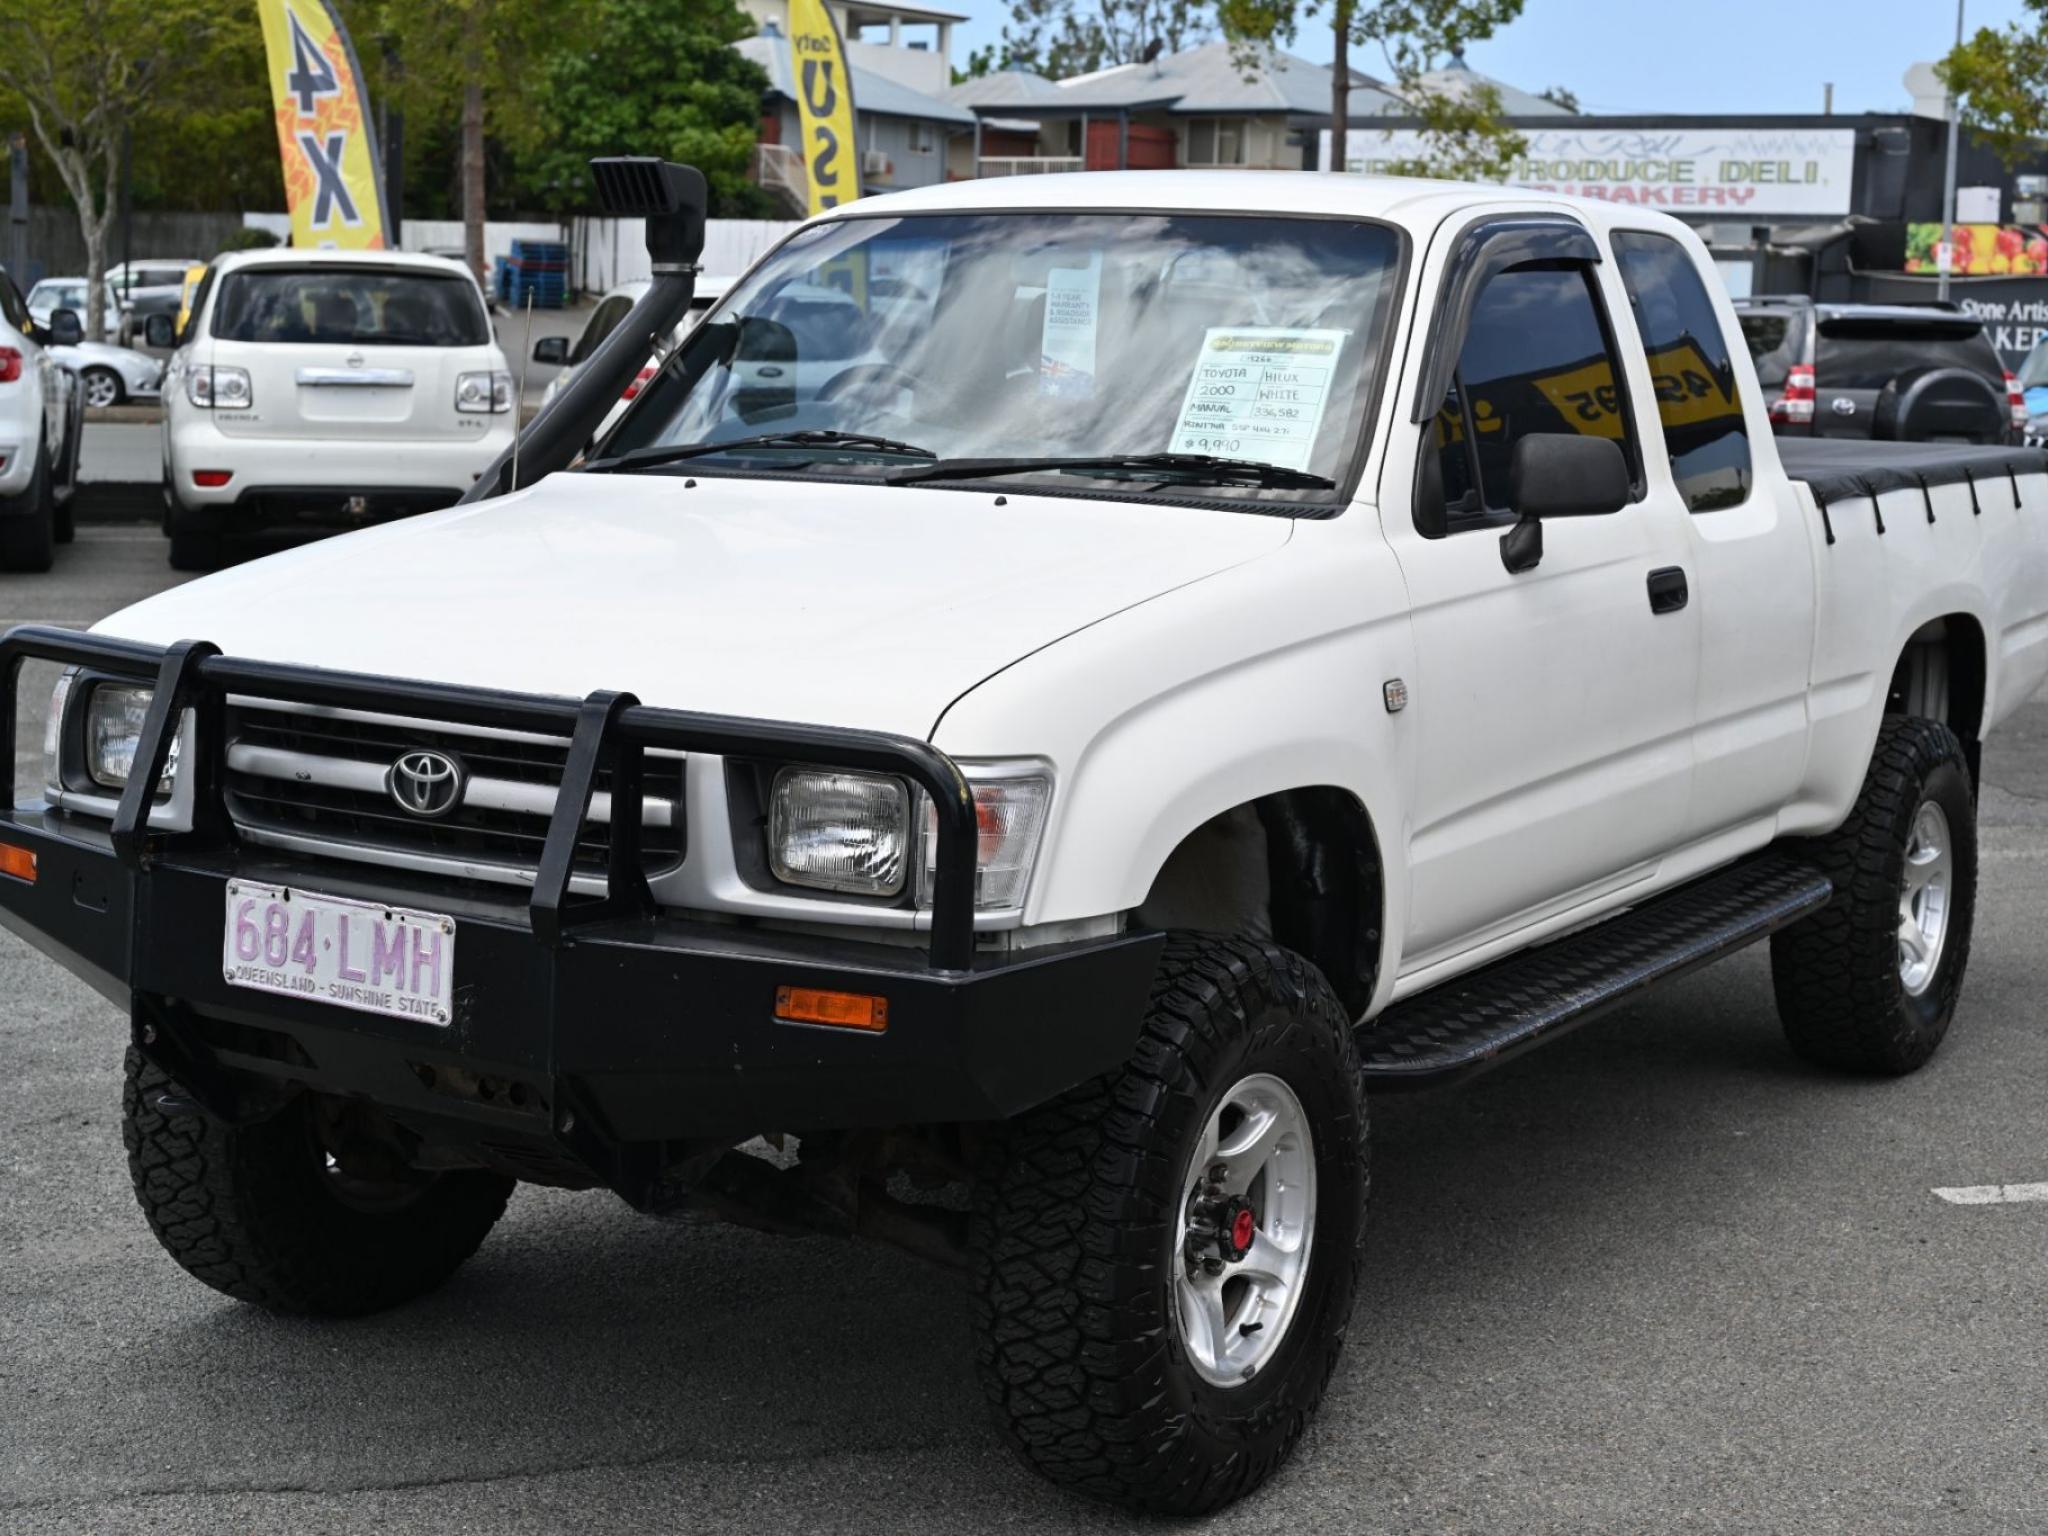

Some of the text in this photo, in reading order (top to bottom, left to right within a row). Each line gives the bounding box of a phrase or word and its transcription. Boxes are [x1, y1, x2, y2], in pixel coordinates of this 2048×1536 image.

[1203, 368, 1299, 383] TOYOTA HILUX
[1200, 385, 1299, 401] 2000 WHITE
[1190, 402, 1232, 414] MANUAL
[236, 965, 316, 994] QUEENSLAND
[328, 983, 392, 1009] SUNSHINE
[399, 996, 438, 1017] STATE
